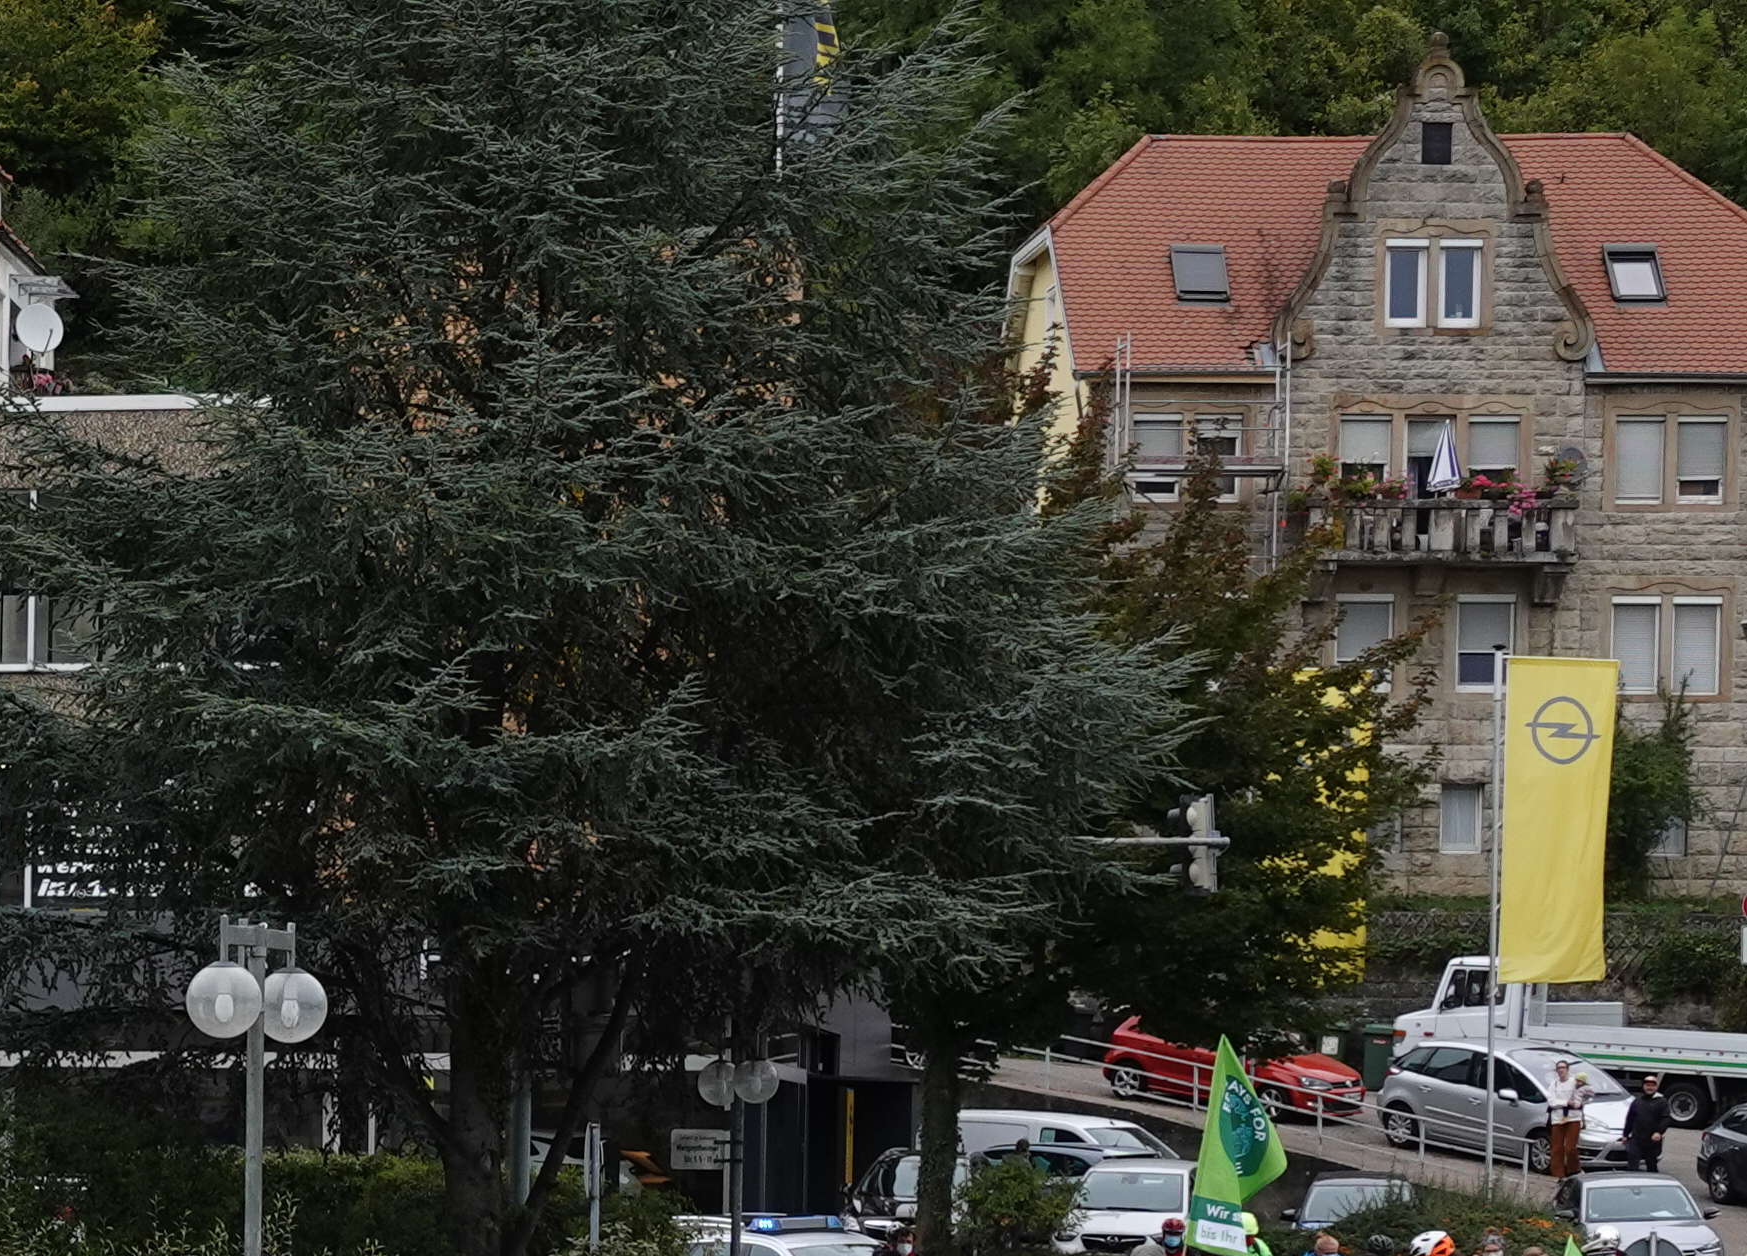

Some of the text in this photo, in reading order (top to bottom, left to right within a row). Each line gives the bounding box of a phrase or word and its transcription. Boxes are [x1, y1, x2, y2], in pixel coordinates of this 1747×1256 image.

[1249, 1108, 1266, 1142] FOR
[1206, 1203, 1230, 1220] Wir
[1200, 1224, 1217, 1241] bis
